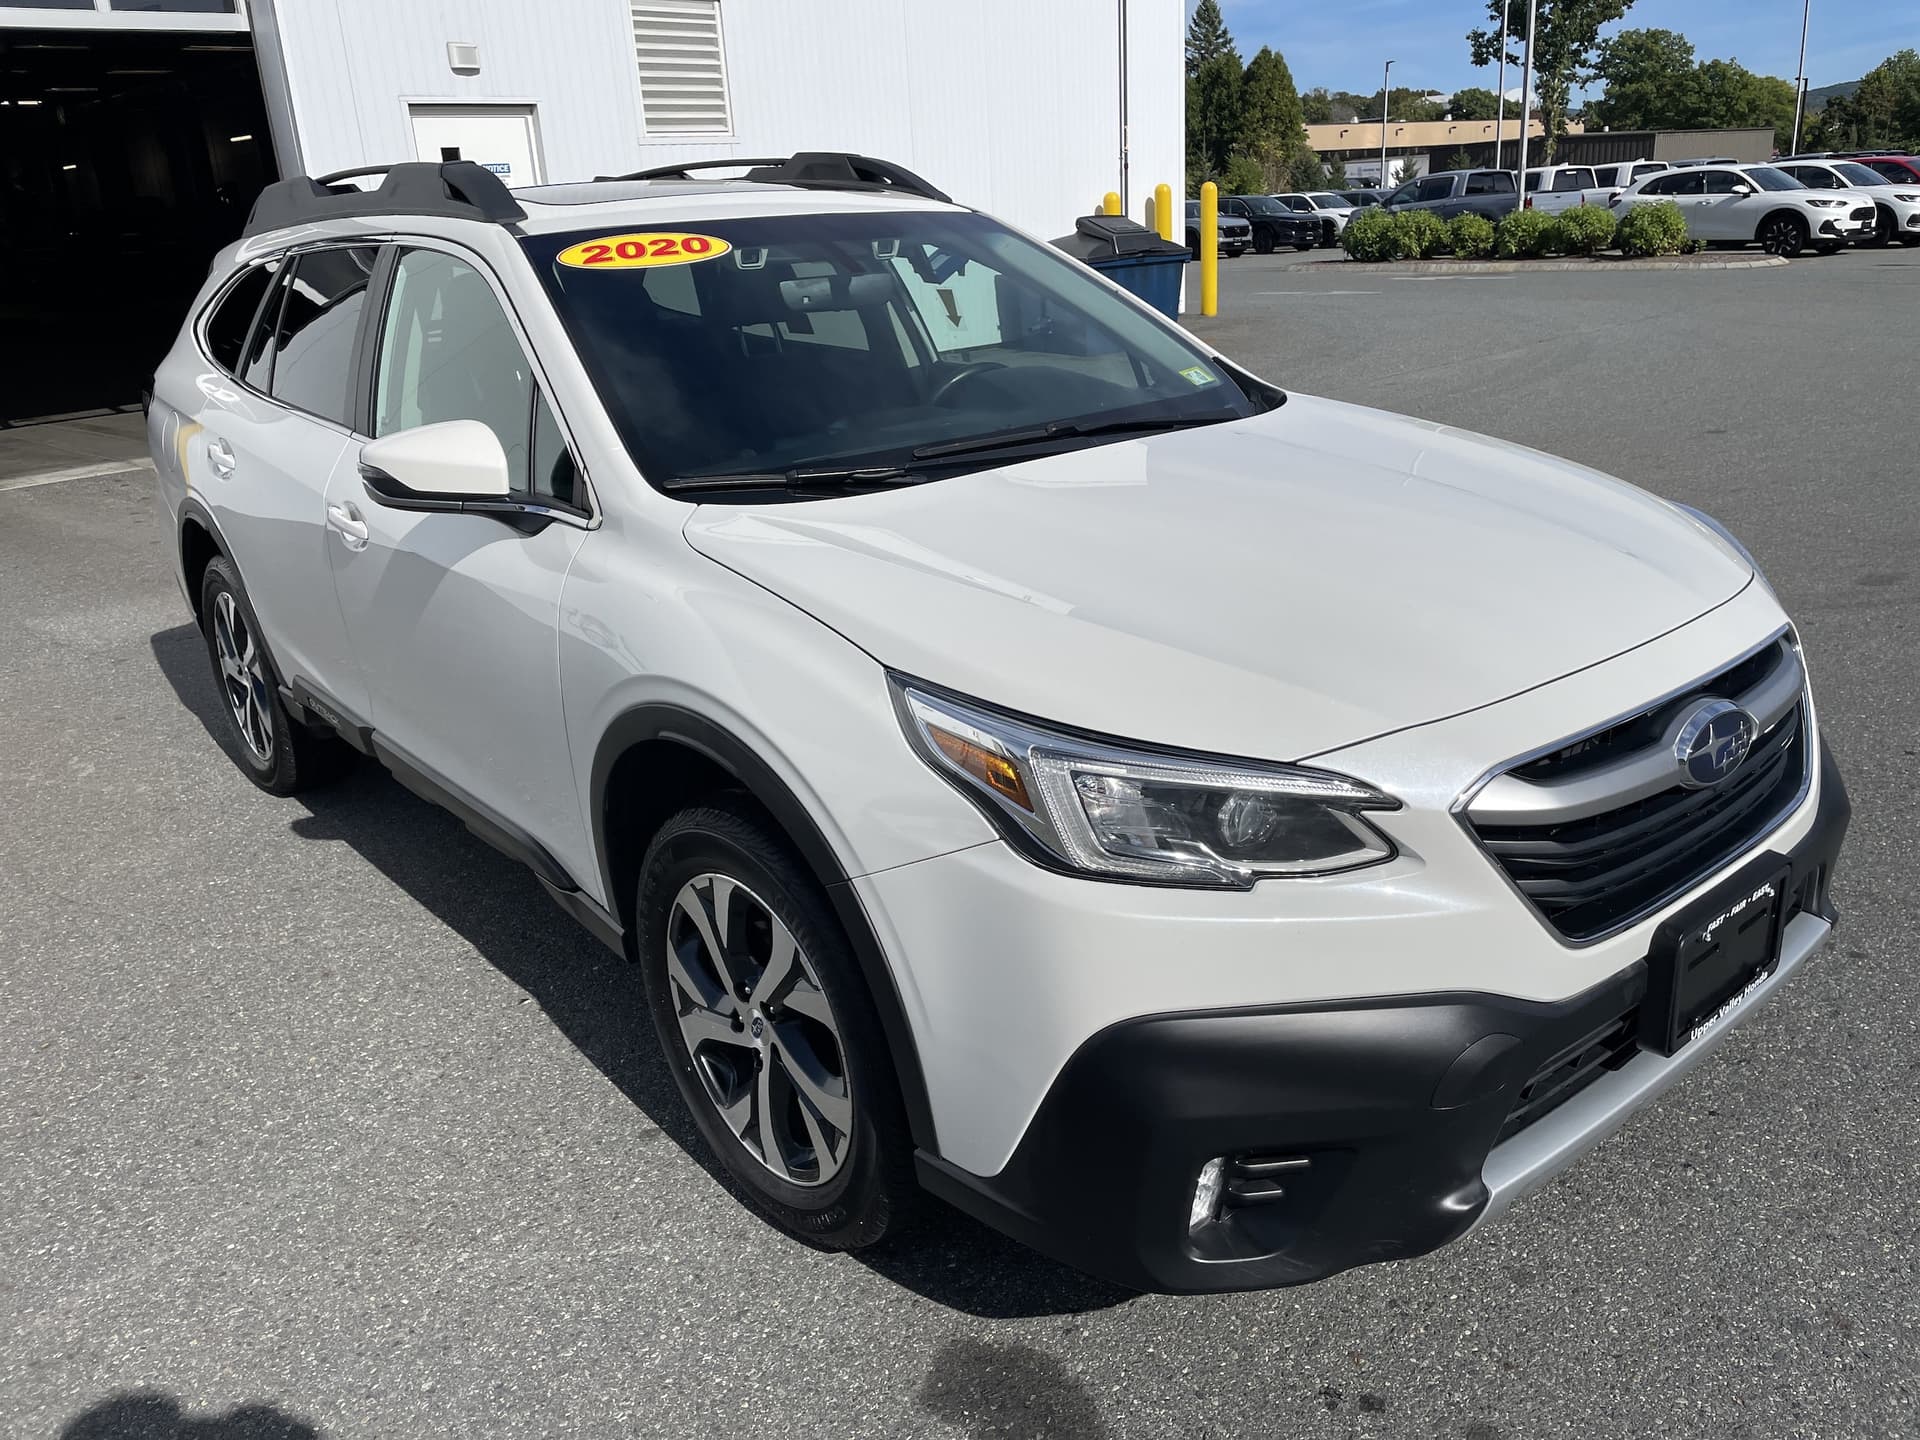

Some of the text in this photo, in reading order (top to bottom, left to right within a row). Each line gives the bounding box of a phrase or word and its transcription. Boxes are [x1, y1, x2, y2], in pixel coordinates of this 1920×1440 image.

[582, 237, 711, 265] 2020
[1707, 914, 1726, 934] FAST
[1690, 971, 1768, 1041] Upper Valley Honda
